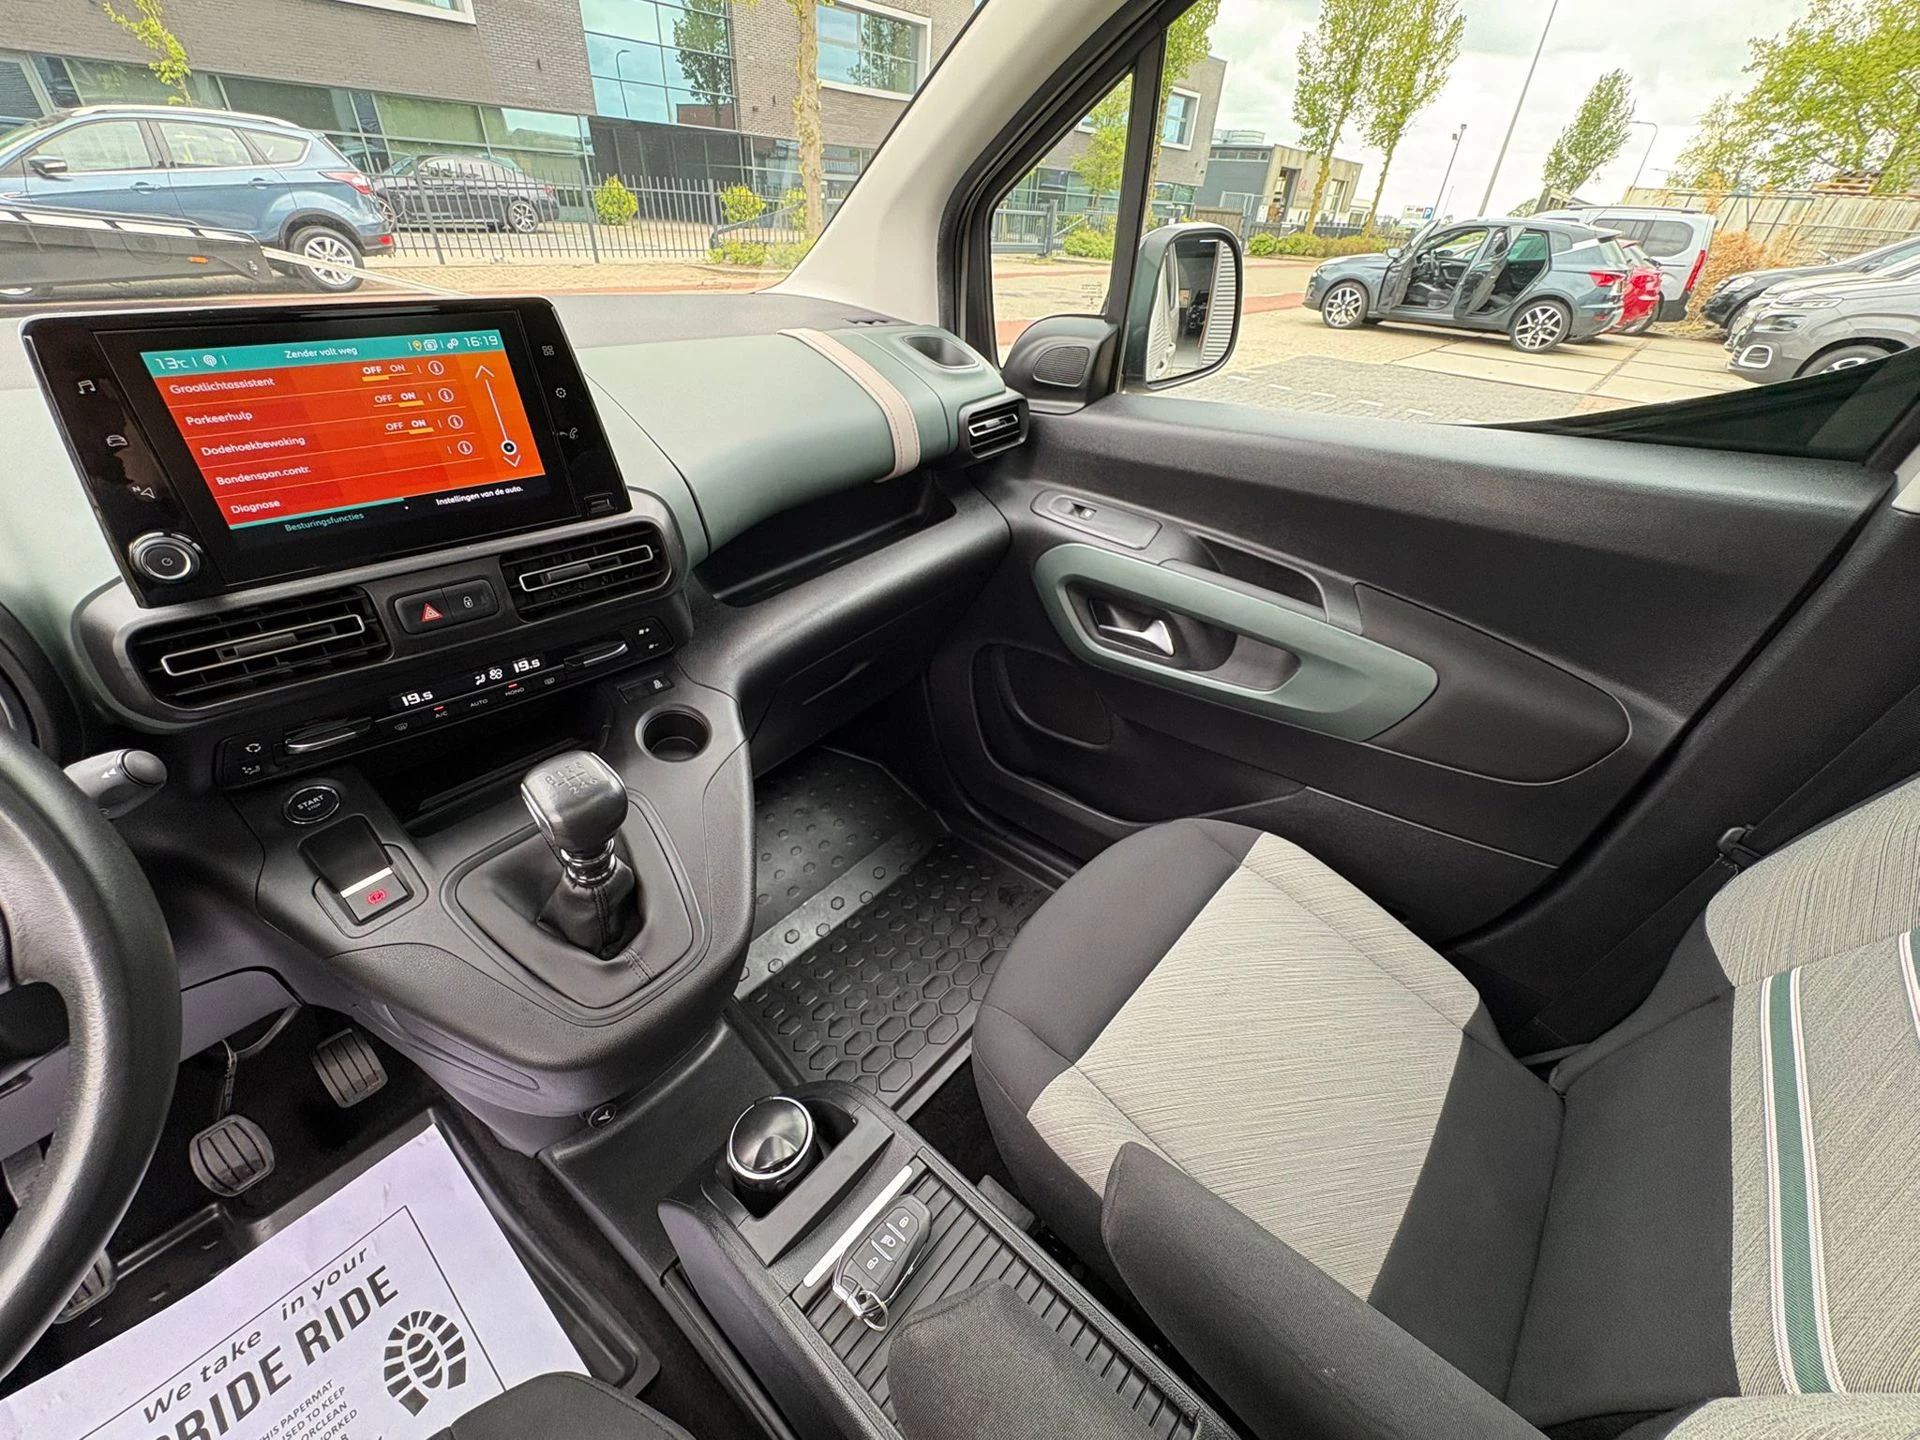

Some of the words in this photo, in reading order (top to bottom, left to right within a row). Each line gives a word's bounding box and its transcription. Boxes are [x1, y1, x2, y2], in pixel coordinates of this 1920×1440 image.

[463, 335, 499, 348] 16:19
[284, 350, 318, 359] Zender
[338, 347, 358, 356] weg
[362, 366, 382, 375] OFF
[389, 363, 406, 373] ON
[169, 377, 276, 395] Grootlichtassistent
[374, 394, 393, 404] OFF
[400, 392, 416, 401] ON
[185, 410, 253, 426] Parkeerhulp
[385, 422, 404, 431] OFF
[411, 419, 427, 428] ON
[201, 436, 306, 457] Dodehoekbewaking
[215, 465, 312, 486] Bandenspan.contr.
[435, 493, 480, 506] Instellingen
[480, 490, 495, 498] van
[494, 488, 504, 496] de
[230, 499, 281, 515] Diagnose
[284, 511, 365, 533] Besturingsfuncties
[505, 687, 525, 696] MONO
[470, 698, 488, 707] AUTO
[435, 711, 448, 719] A/C
[297, 794, 324, 810] START
[143, 1382, 192, 1424] We
[200, 1330, 262, 1382] take
[281, 1296, 305, 1321] in
[312, 1248, 367, 1299] your
[155, 1345, 292, 1440] RIDE
[294, 1265, 399, 1366] RIDE
[259, 1425, 280, 1440] HIS
[280, 1379, 333, 1429] PAPERMAT
[305, 1408, 320, 1421] TO
[322, 1386, 345, 1410] KEEP
[320, 1409, 357, 1440] ORKED
